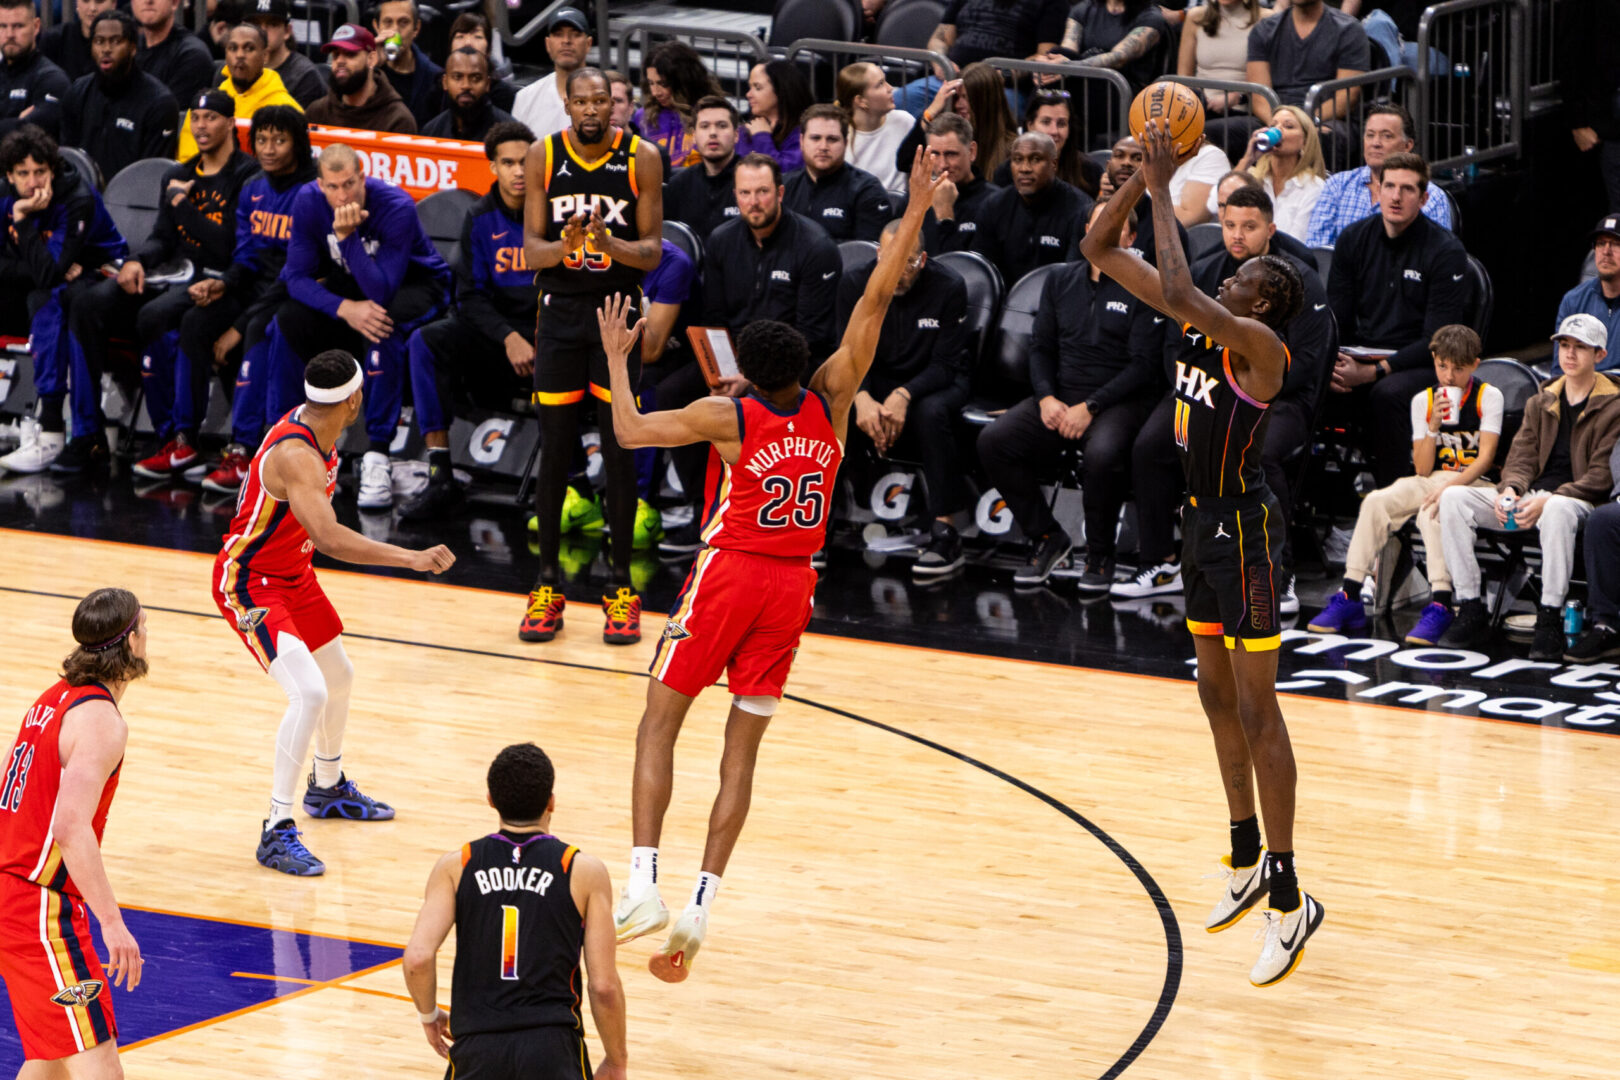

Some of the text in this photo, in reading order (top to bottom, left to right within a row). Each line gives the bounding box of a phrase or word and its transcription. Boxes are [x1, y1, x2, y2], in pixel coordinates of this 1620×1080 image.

[311, 146, 458, 190] ORADE
[605, 163, 627, 171] PayPal
[550, 193, 629, 227] PHX
[823, 207, 844, 218] PHX
[771, 270, 791, 282] PHX
[918, 318, 940, 329] PHX
[1106, 301, 1128, 314] PHX
[1175, 360, 1219, 409] HX
[744, 436, 819, 478] MURPHY
[757, 471, 825, 529] 25
[1280, 629, 1620, 700] mort
[0, 741, 35, 813] 13
[474, 866, 554, 897] BOOKER
[501, 904, 520, 981] 1
